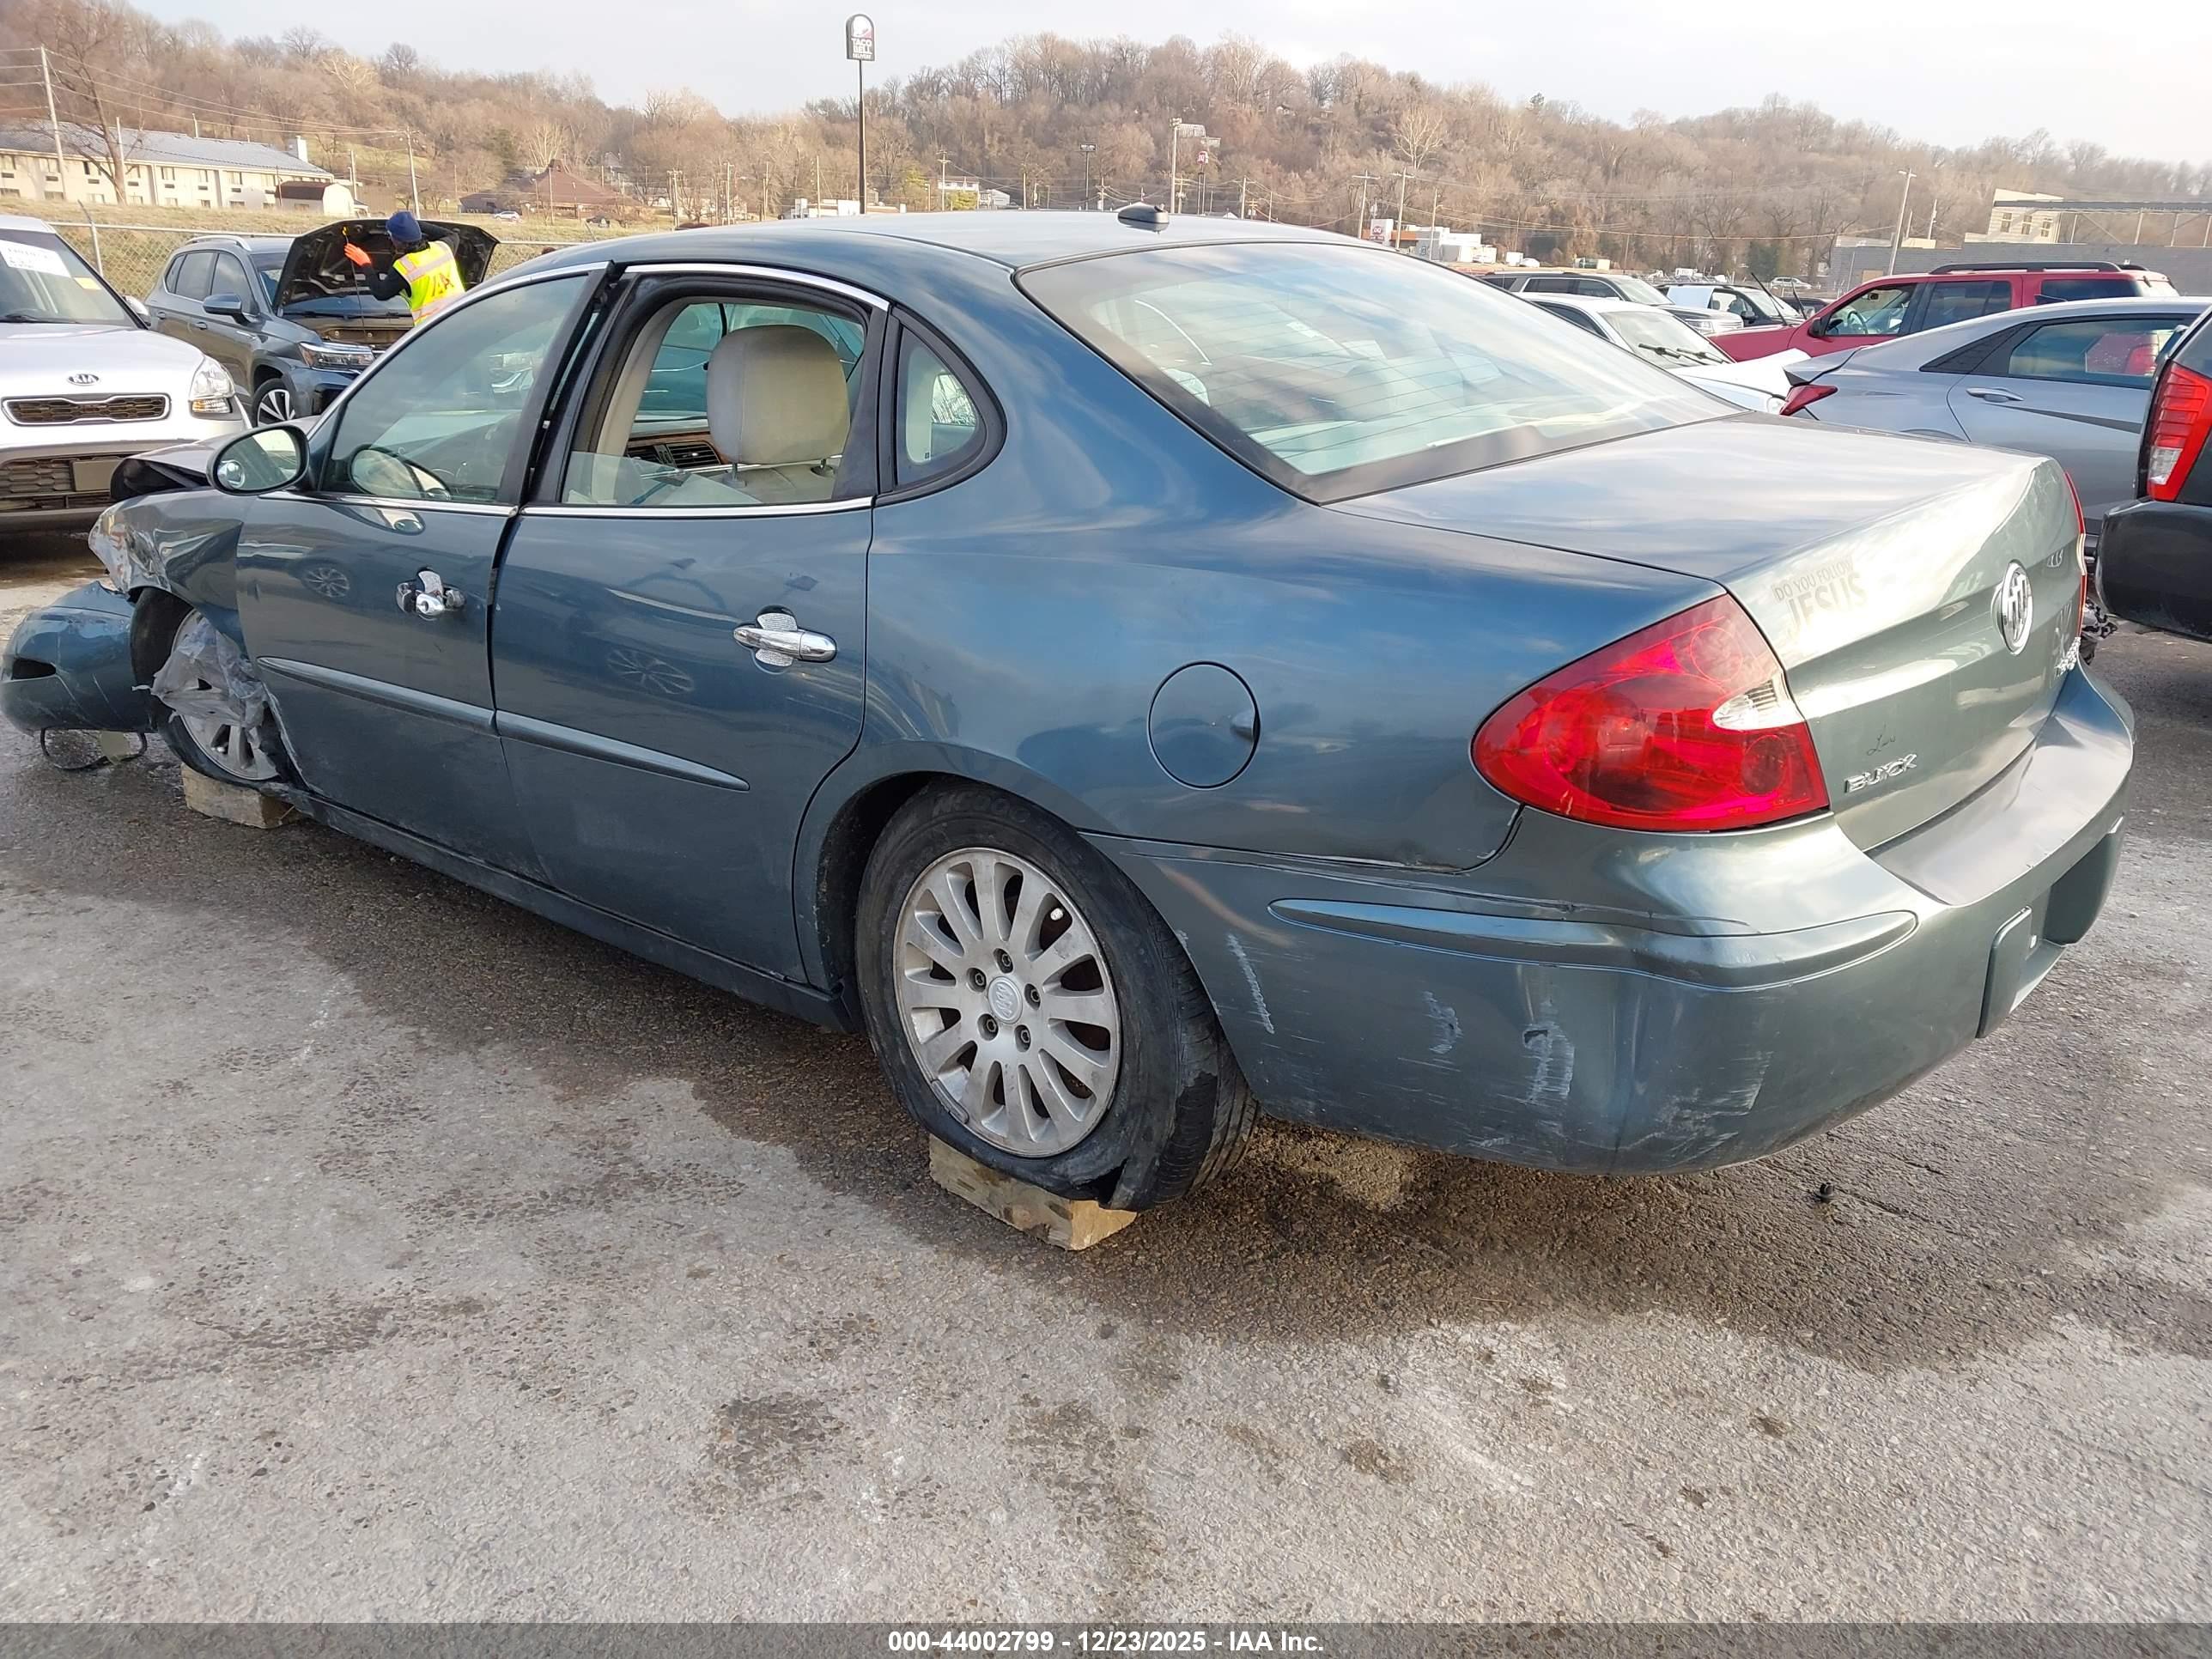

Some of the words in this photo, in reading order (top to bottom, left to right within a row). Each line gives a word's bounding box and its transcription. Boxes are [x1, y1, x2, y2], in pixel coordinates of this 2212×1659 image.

[851, 37, 872, 46] TACO
[853, 45, 872, 54] BELL
[70, 374, 99, 384] KIA
[1773, 582, 1794, 602] DO
[1793, 574, 1818, 595] YOU
[1815, 556, 1855, 584] FOLLOW
[1786, 572, 1868, 634] JESUS
[1844, 753, 1917, 794] BUICK
